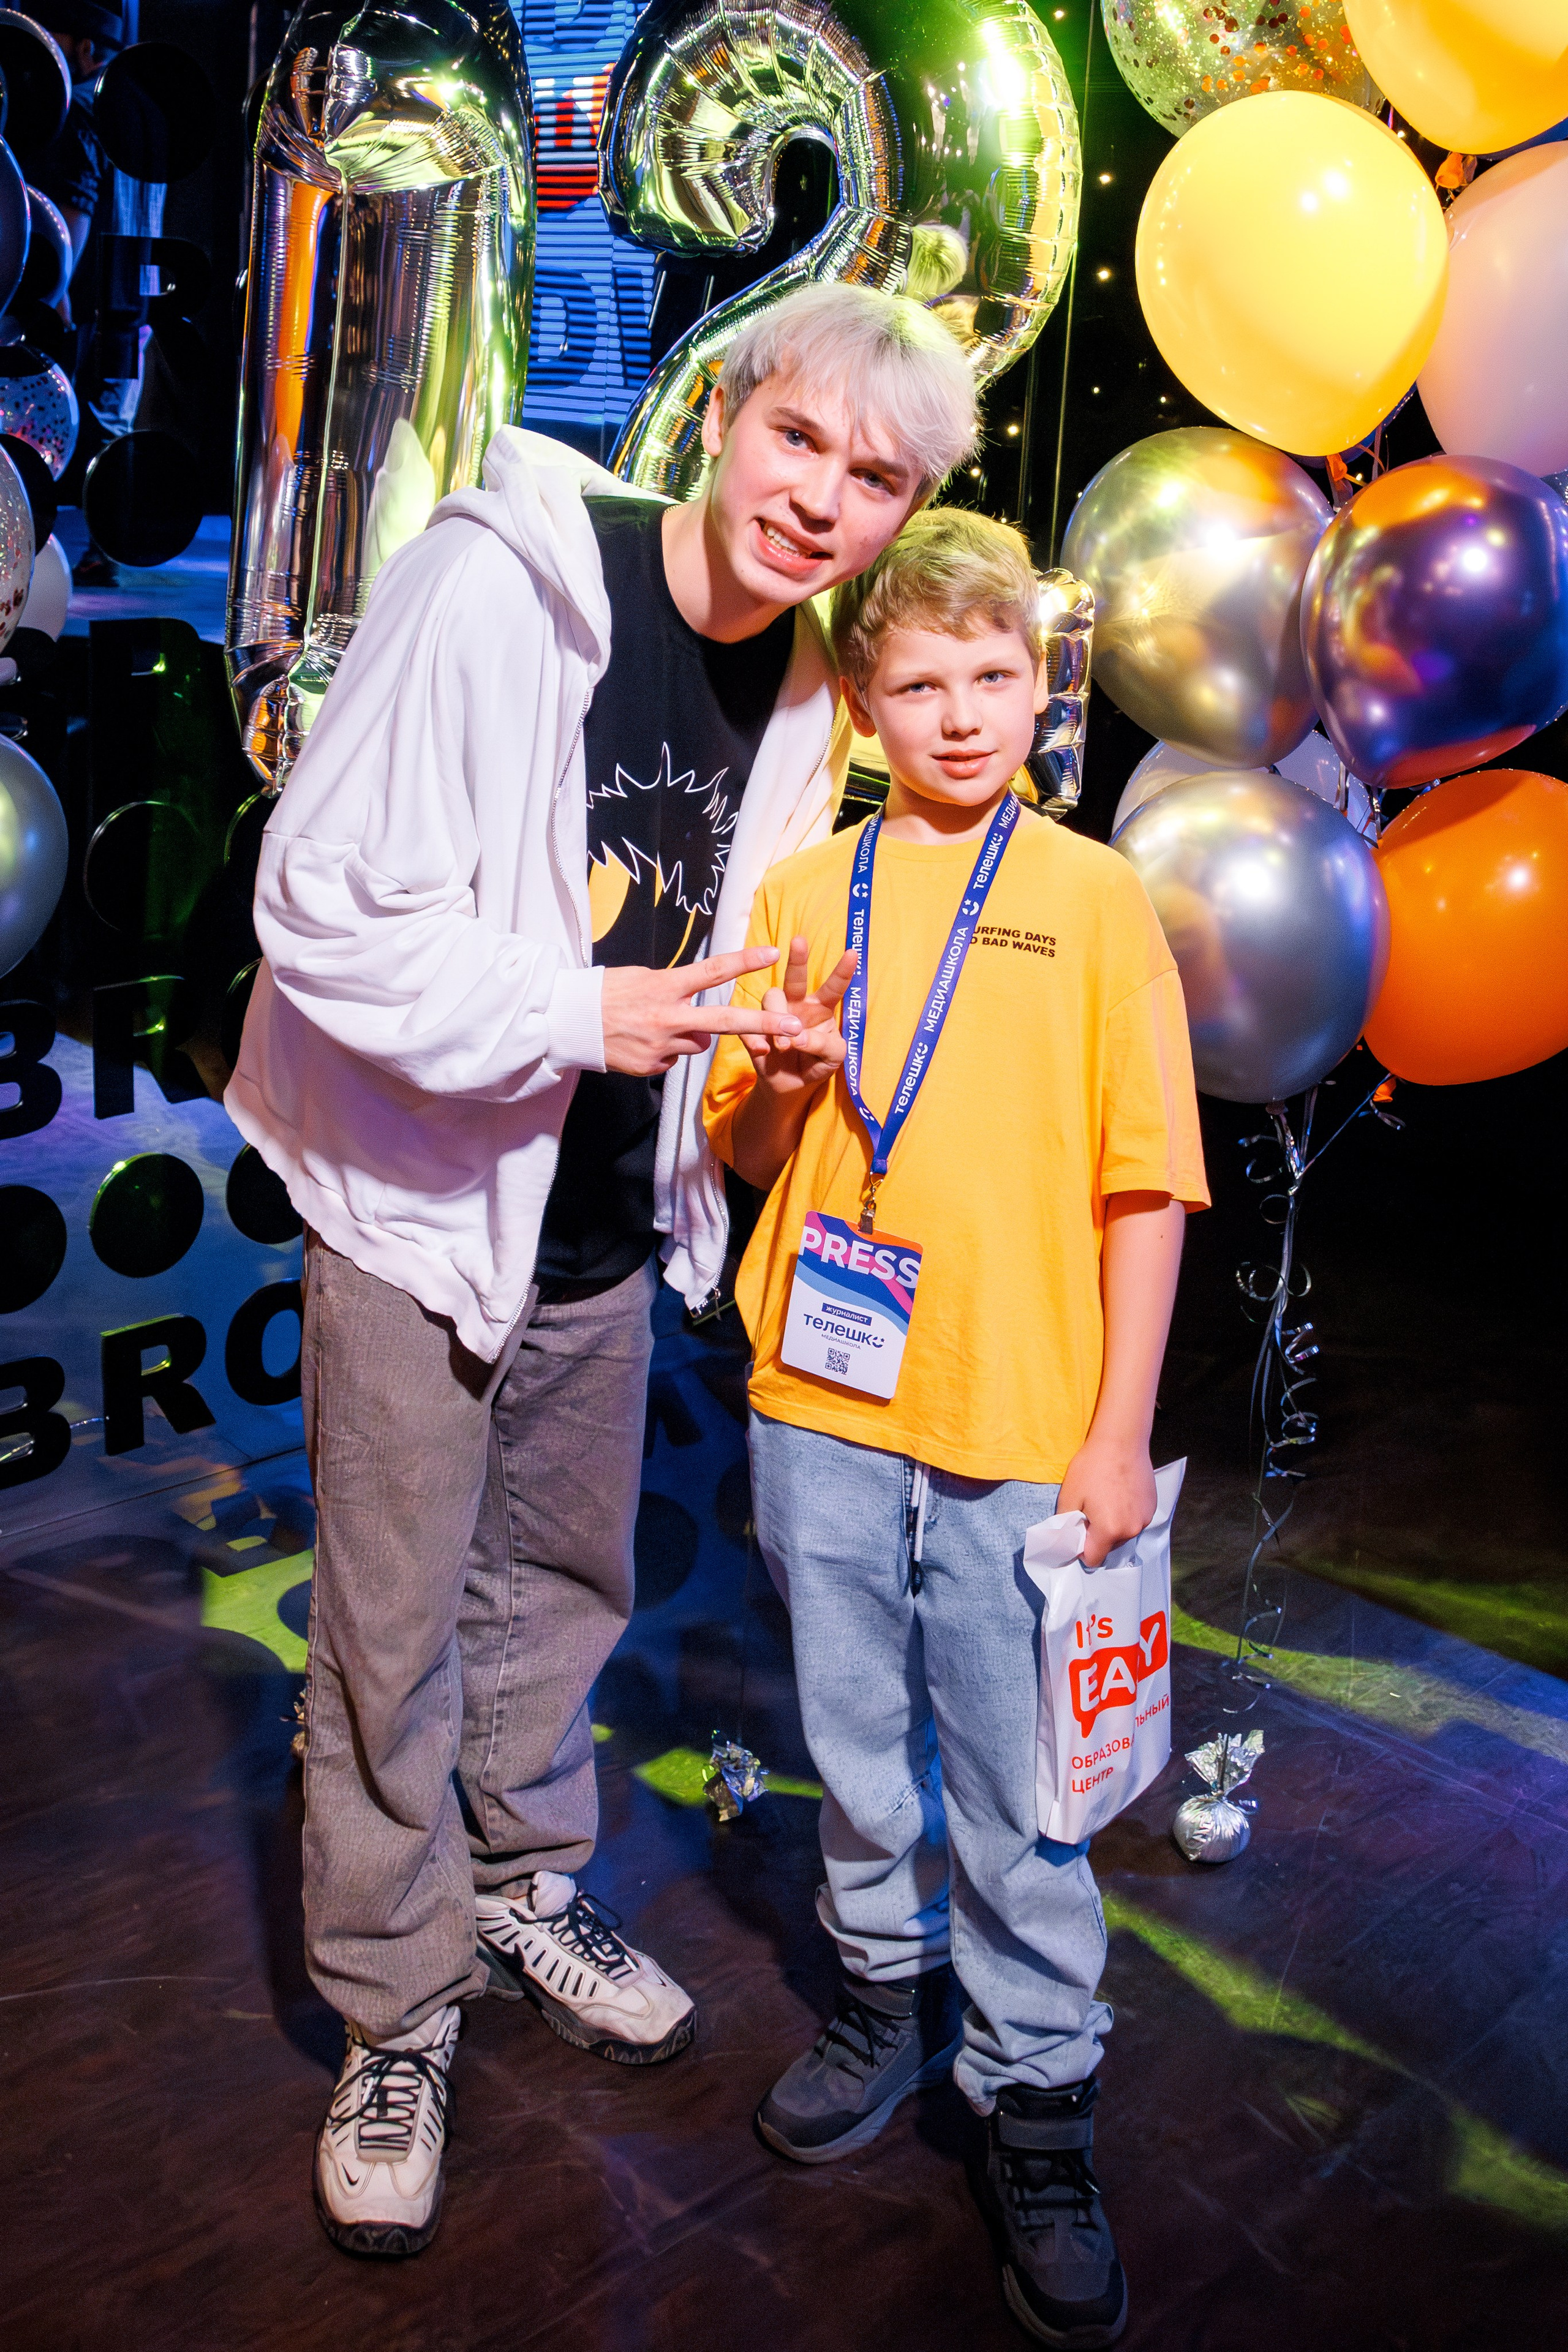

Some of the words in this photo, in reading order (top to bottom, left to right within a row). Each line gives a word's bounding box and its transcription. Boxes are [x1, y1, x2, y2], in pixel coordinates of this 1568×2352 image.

[858, 810, 880, 873] ДИАШКОЛА
[924, 926, 969, 1033] МЕДИАШКОЛА
[998, 795, 1020, 829] МЕДИА
[973, 925, 1021, 938] URFING
[1025, 932, 1057, 946] DAYS
[982, 937, 1008, 948] BAD
[1012, 940, 1056, 957] WAVES
[846, 987, 861, 1096] МЕДИАШКОЛА
[798, 1226, 921, 1289] PRESS
[825, 1305, 869, 1324] журналист
[821, 1333, 861, 1350] МЕДИАШКОЛА
[1072, 1766, 1114, 1794] ЦЕНТР
